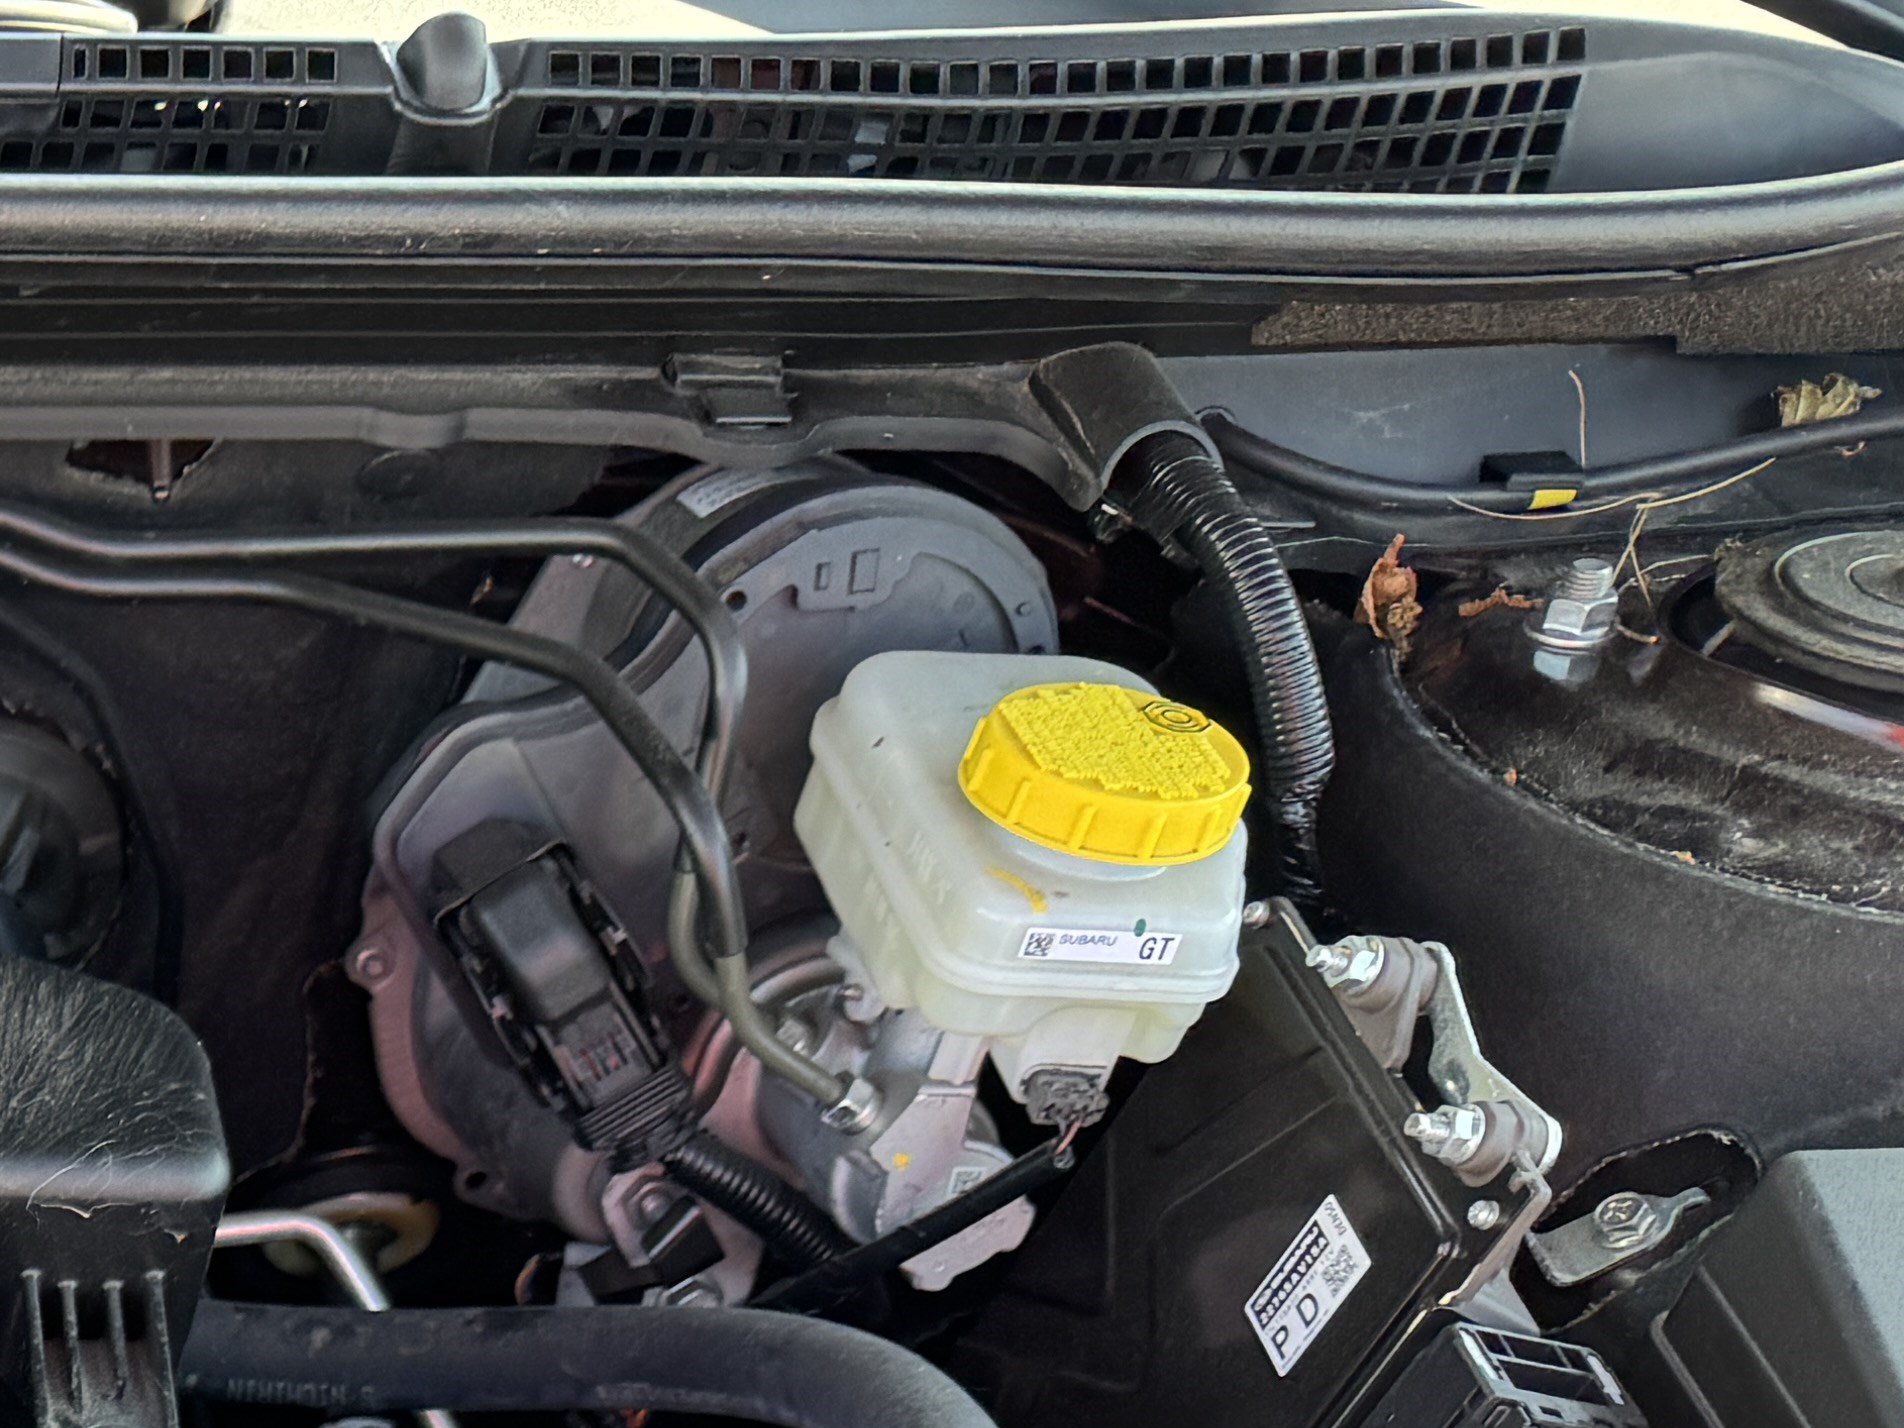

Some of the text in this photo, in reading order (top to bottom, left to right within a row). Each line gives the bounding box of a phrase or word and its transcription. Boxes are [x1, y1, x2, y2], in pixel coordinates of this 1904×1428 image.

[1059, 933, 1175, 961] SUBARU GT
[1271, 1324, 1290, 1360] P
[1295, 1292, 1319, 1329] D
